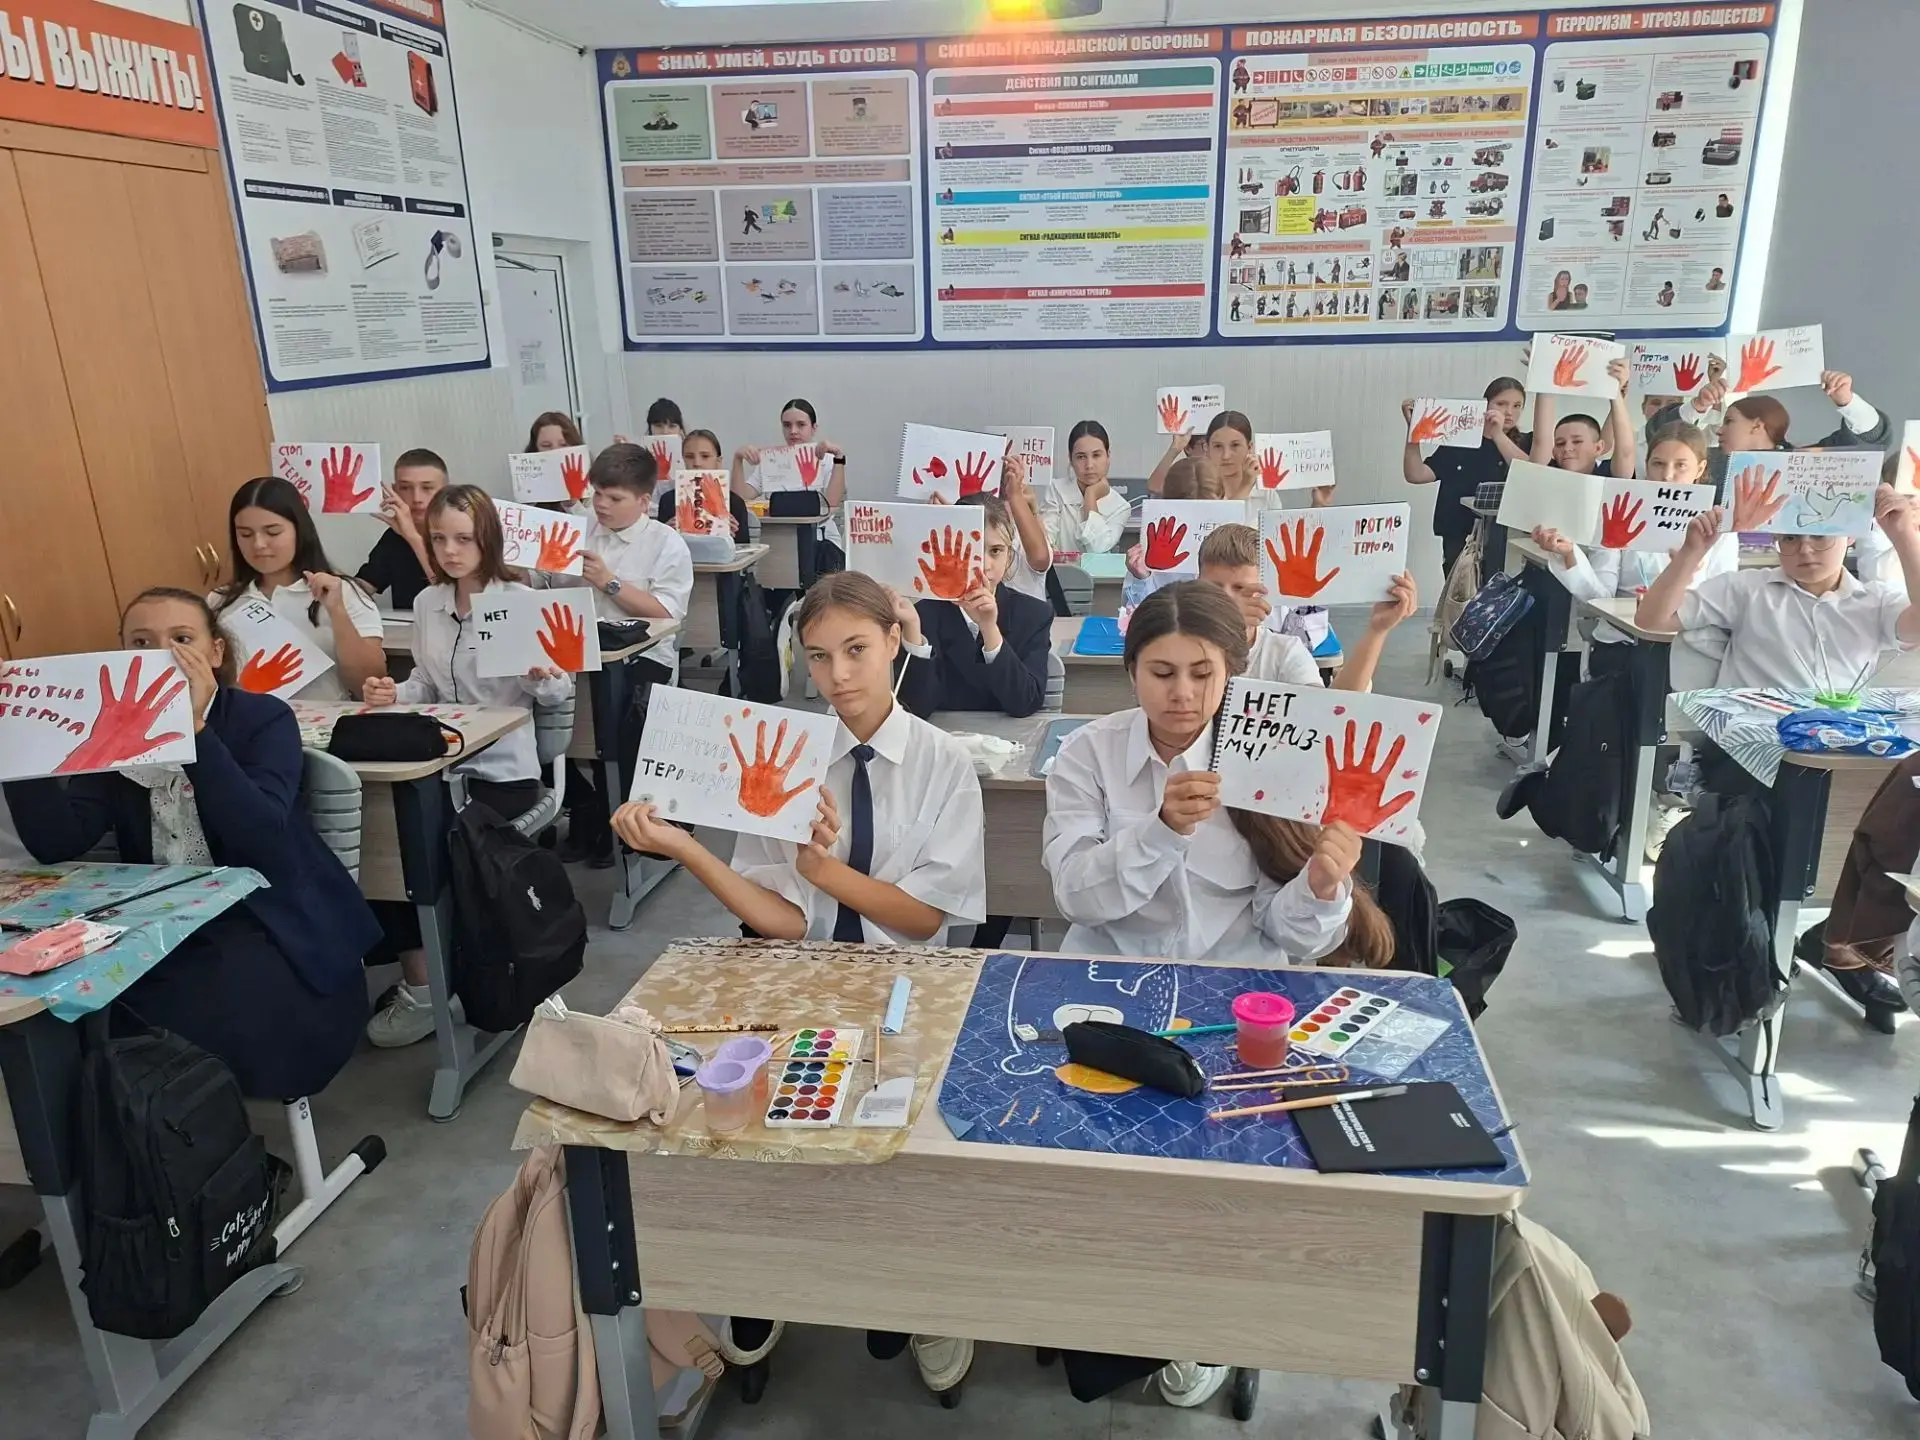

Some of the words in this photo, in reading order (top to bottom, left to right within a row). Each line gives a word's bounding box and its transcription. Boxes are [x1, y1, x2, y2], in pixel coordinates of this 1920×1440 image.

[1556, 14, 1632, 33] ТЕРРОРИЗМ
[1642, 10, 1690, 29] УГРОЗА
[1692, 7, 1767, 27] ОБЩЕСТВУ
[1246, 27, 1356, 46] ПОЖАРНАЯ
[1361, 20, 1523, 42] БЕЗОПАСНОСТЬ
[938, 42, 1012, 58] СИГНАЛЫ
[1014, 34, 1128, 57] ГРАЖДАНСКОЙ
[1131, 33, 1210, 51] ОБОРОНЫ
[43, 20, 205, 113] ВЫЖИТЬ!
[657, 52, 712, 70] ЗНАЙ,
[714, 49, 770, 68] УМЕЙ,
[772, 50, 825, 67] БУДЬ
[829, 46, 897, 64] ГОТОВ!
[1469, 63, 1493, 75] ВЫХОД
[1005, 76, 1061, 90] ДЕЙСТВИЯ
[1063, 76, 1078, 87] ПО
[1080, 73, 1139, 87] СИГНАЛАМ
[1640, 354, 1669, 362] ПРОТИВ
[279, 445, 303, 456] СТОП
[1023, 438, 1046, 451] НЕТ
[1657, 487, 1693, 501] НЕТ
[1652, 505, 1706, 517] ТЕРОРИ
[850, 515, 893, 533] ПРОТИВ
[1354, 515, 1402, 538] ПРОТИВ
[242, 602, 276, 624] НЕТ
[484, 609, 508, 623] НЕТ
[3, 667, 40, 678] МЫ
[0, 682, 85, 700] ПРОТИВ
[1243, 690, 1297, 718] НЕТ
[0, 702, 85, 736] ТЕРРОРА
[1223, 738, 1268, 762] МУ!
[221, 1210, 246, 1243] Cats
[226, 1235, 252, 1267] happy
